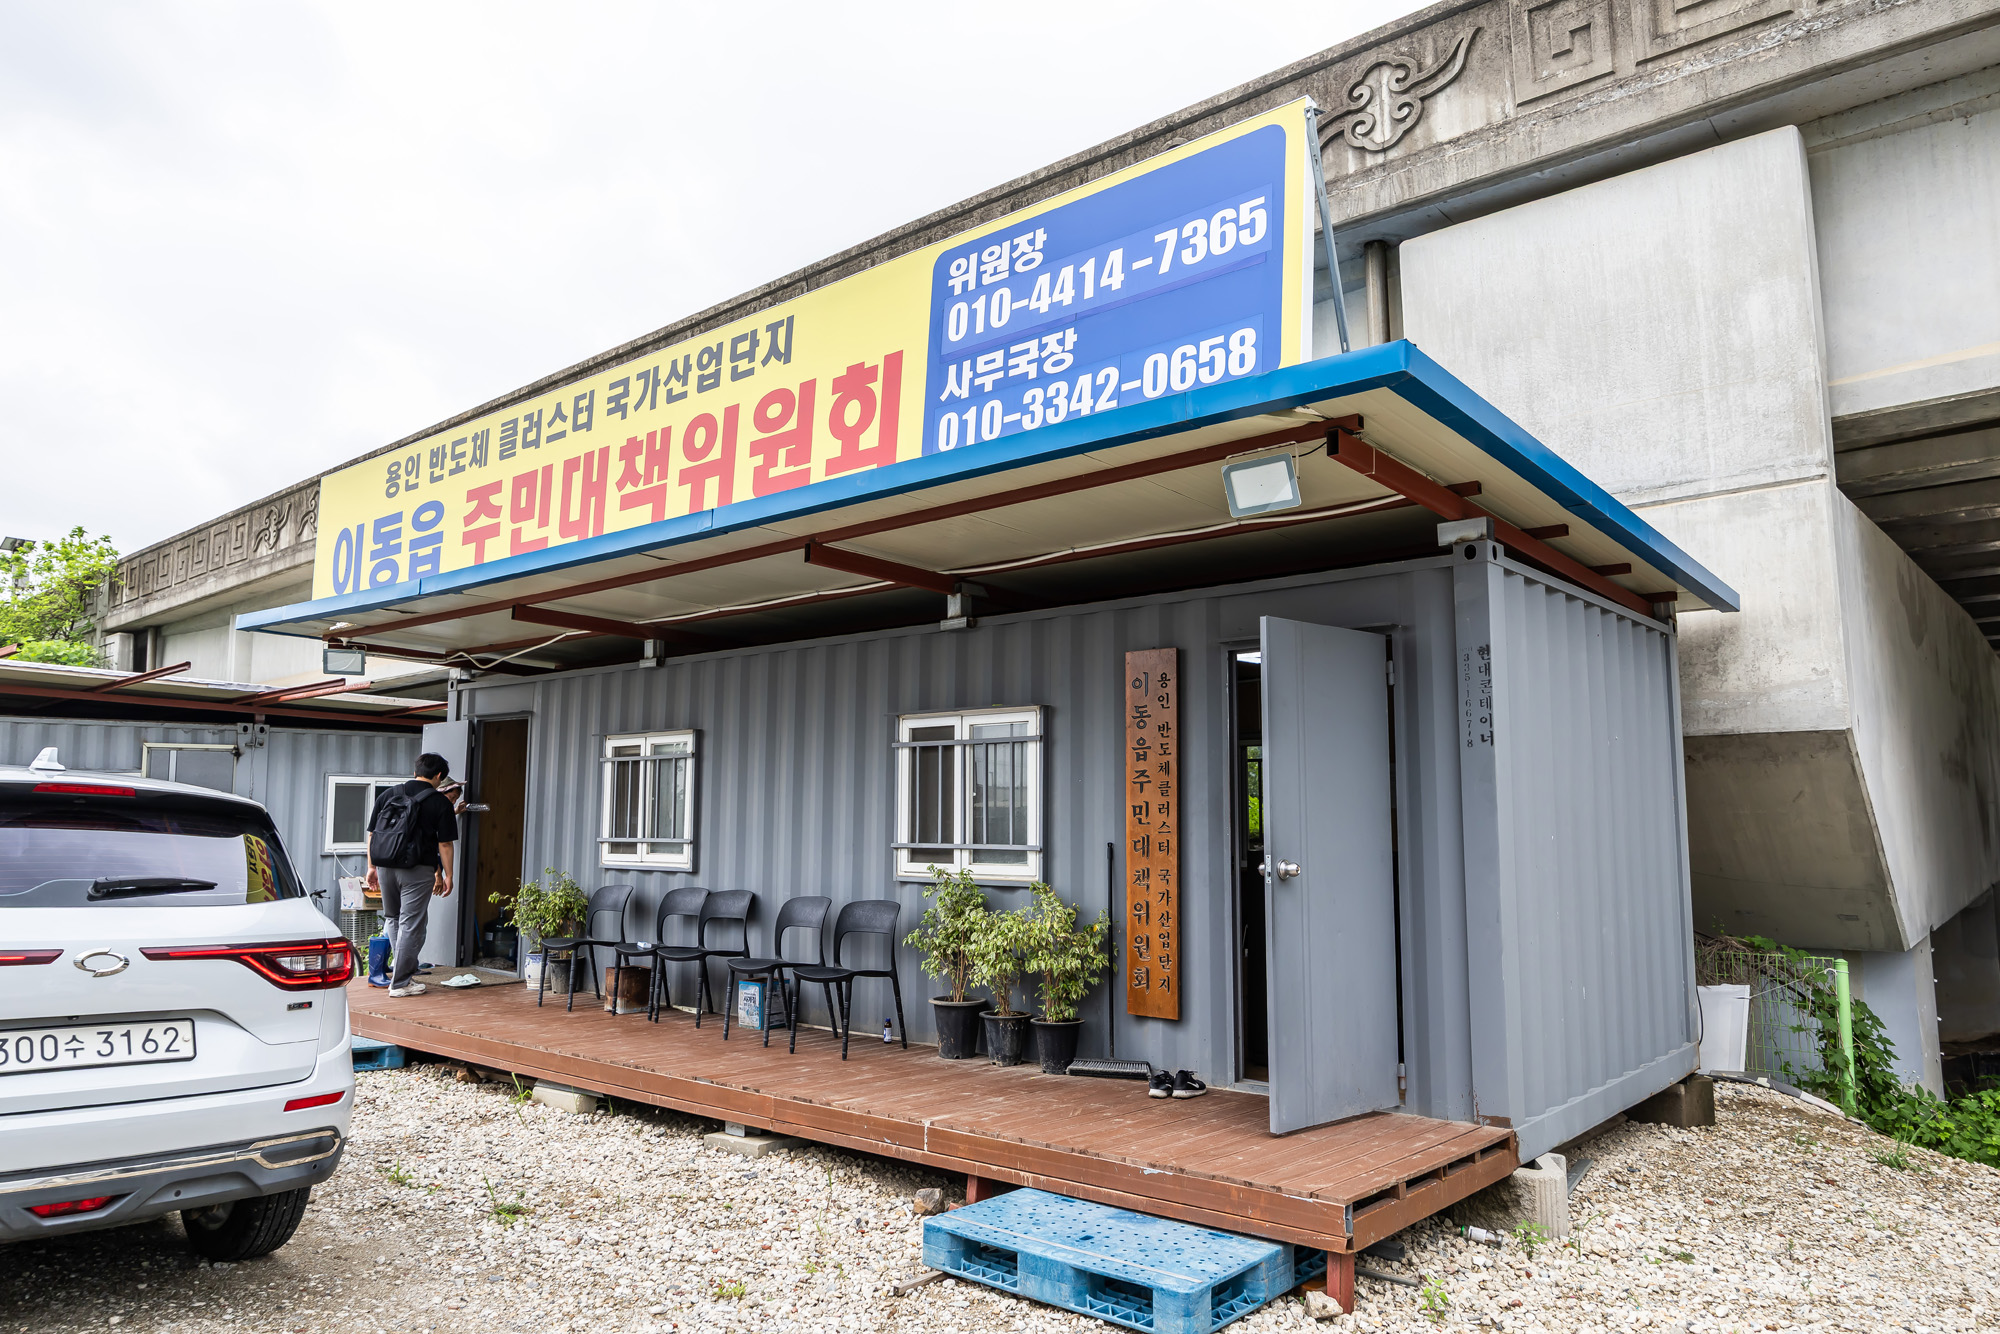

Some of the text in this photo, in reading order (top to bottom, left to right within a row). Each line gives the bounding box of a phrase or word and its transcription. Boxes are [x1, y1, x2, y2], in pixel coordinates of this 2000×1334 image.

[948, 228, 1047, 295] 위원장
[948, 197, 1268, 342] 010-4414-7365
[385, 315, 795, 498] 용인 반도체 클러스터 국가산업단지
[938, 327, 1257, 452] 010-3342-0658
[940, 327, 1077, 401] 사무국장
[332, 349, 904, 595] 이동읍 주민대책위원회
[1157, 672, 1171, 709] 용인
[1477, 644, 1494, 746] 현대콘테이너
[1157, 868, 1172, 995] 국가산업단지
[96, 1027, 180, 1057] 3162
